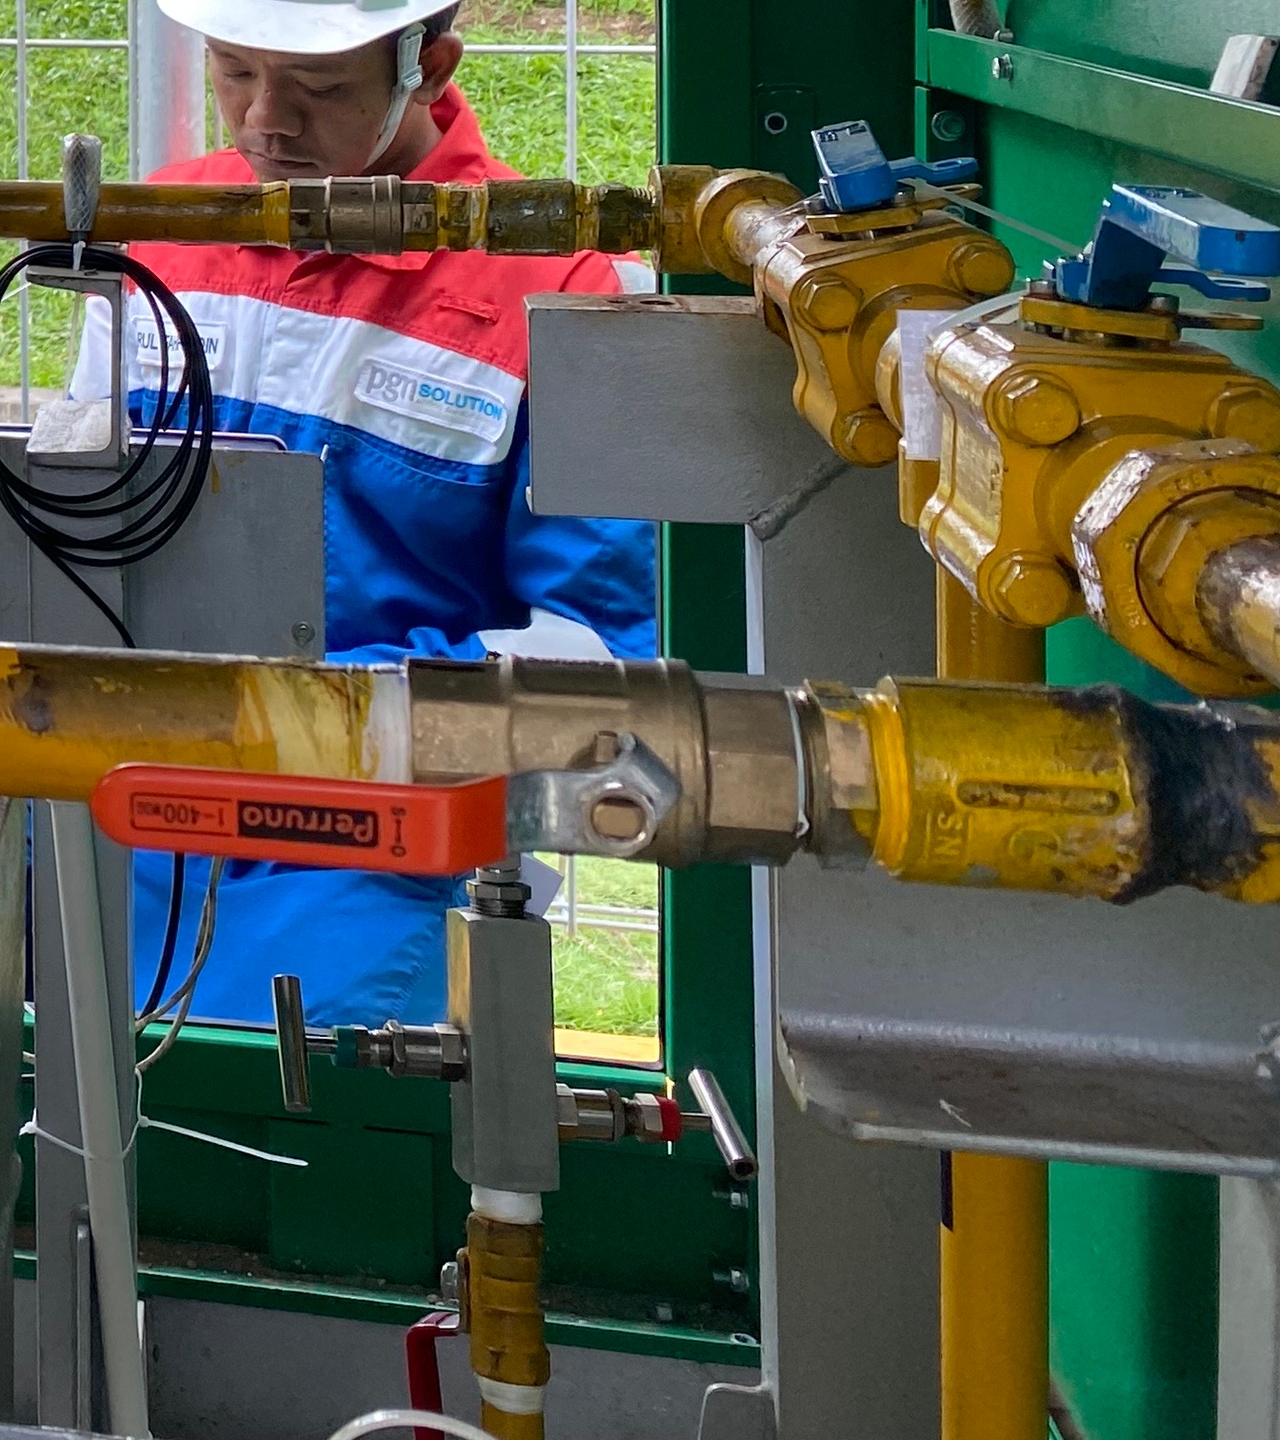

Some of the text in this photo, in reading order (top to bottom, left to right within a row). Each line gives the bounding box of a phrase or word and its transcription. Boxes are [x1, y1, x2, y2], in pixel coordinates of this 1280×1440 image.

[366, 366, 418, 403] pgn
[418, 383, 504, 421] SOLUTION
[241, 804, 376, 844] Perruno
